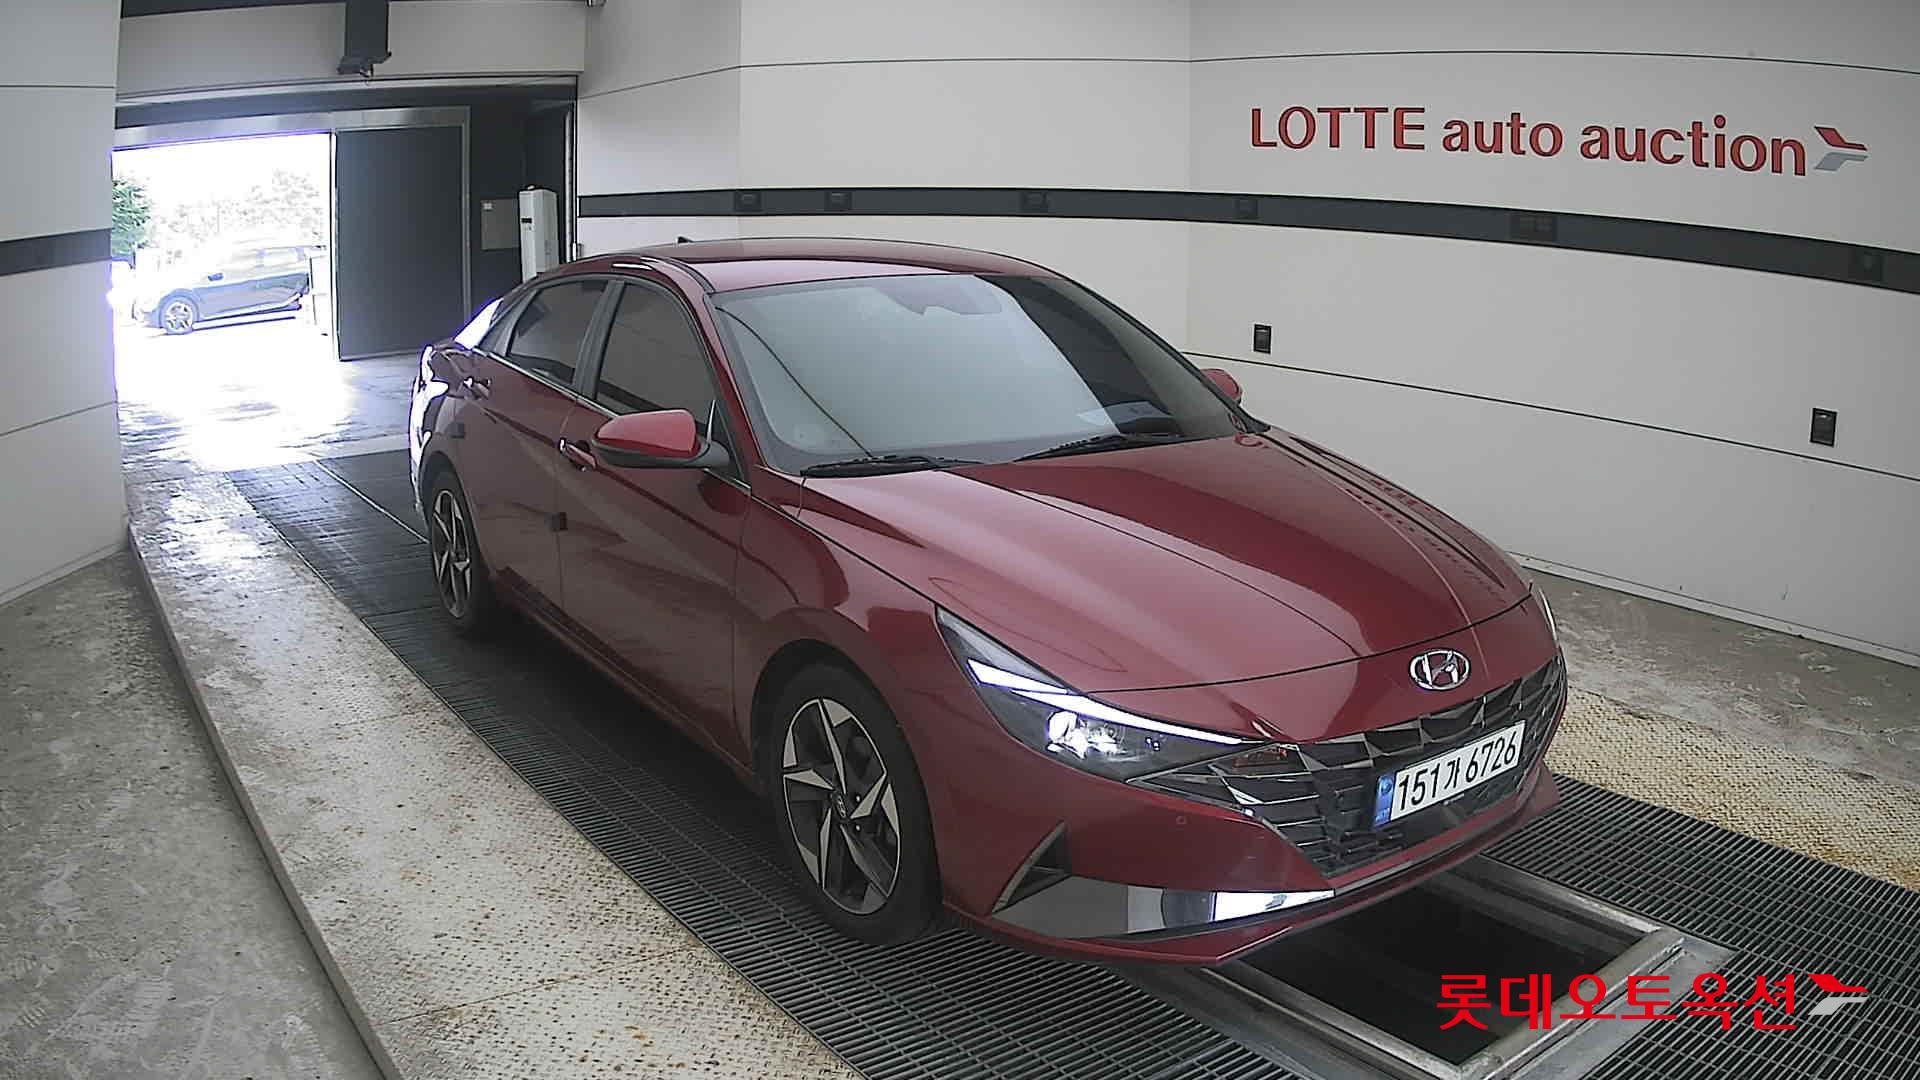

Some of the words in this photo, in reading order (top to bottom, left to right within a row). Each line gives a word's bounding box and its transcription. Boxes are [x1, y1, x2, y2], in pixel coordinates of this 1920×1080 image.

[1250, 106, 1426, 150] LOTTE
[1442, 112, 1564, 156] auto
[1579, 115, 1806, 176] auction
[1465, 731, 1517, 783] 6726
